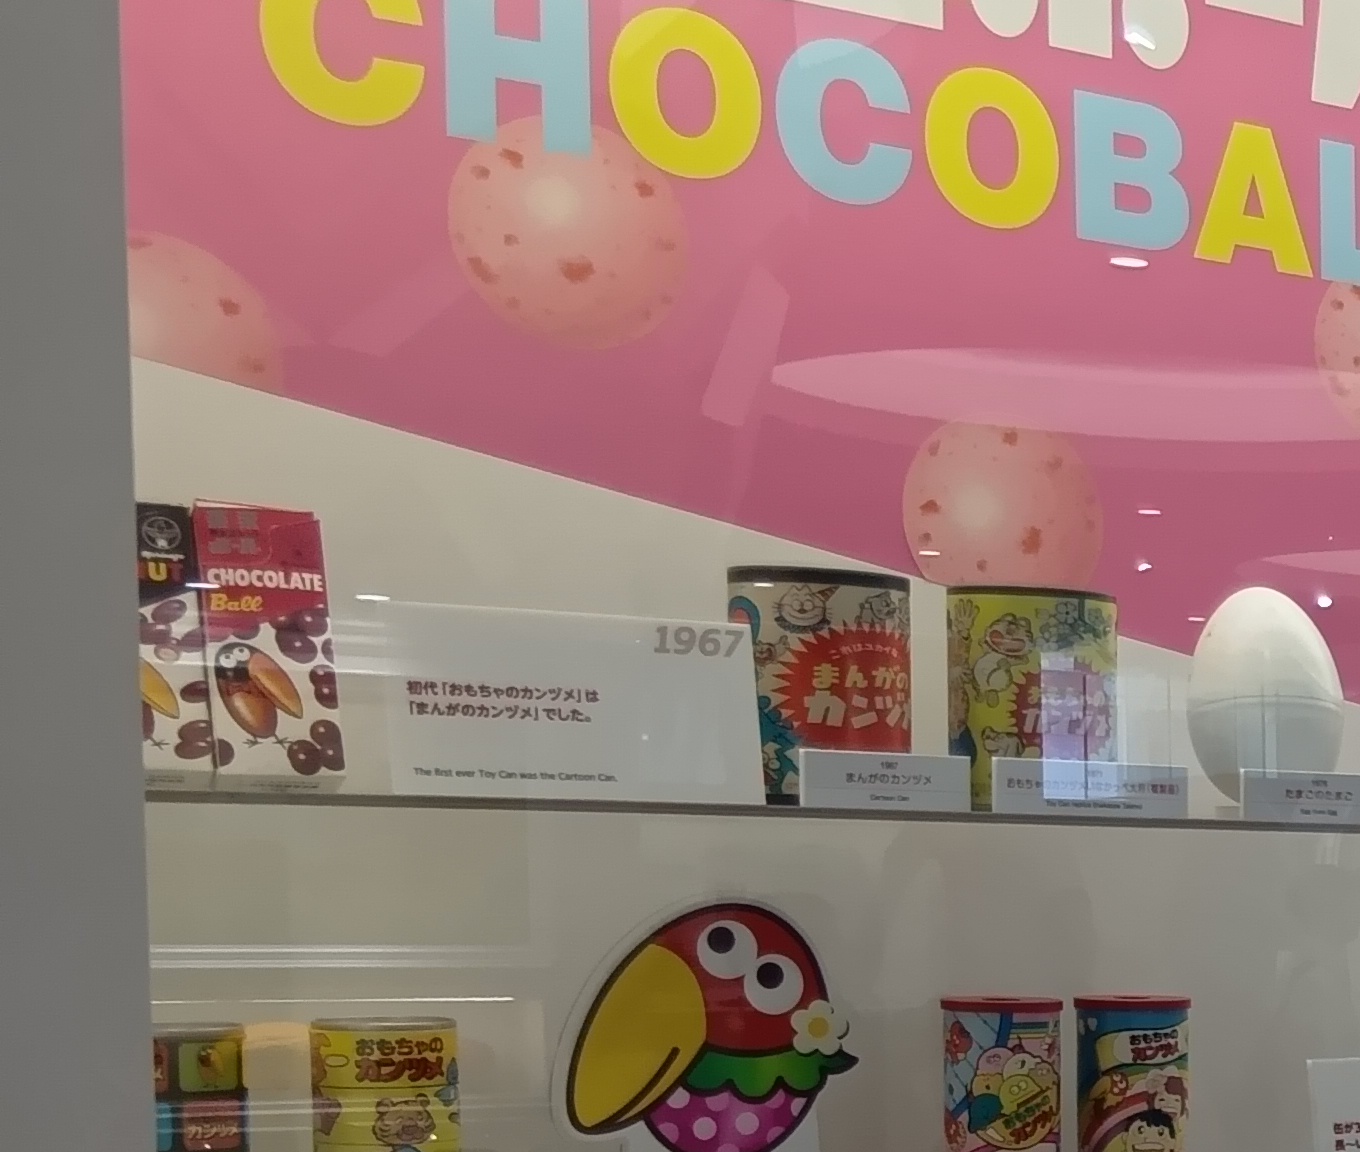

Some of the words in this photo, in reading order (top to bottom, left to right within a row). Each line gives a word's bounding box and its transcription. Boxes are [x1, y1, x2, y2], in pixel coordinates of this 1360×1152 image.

[207, 568, 324, 592] CHOCOLATE
[210, 593, 263, 612] Ball
[653, 625, 745, 658] 1967
[812, 663, 908, 690] まんがの
[406, 680, 600, 703] 初代「おもちゃのカンヅメ」は
[409, 701, 592, 723] 「まんがのカンヅメ」でした。
[413, 767, 432, 777] The
[455, 770, 475, 779] ever
[478, 769, 496, 781] Toy
[498, 770, 517, 780] Can
[519, 772, 537, 781] was
[540, 771, 555, 781] the
[845, 773, 932, 786] まんがのカンヅメ
[355, 1037, 444, 1056] おもちゃの
